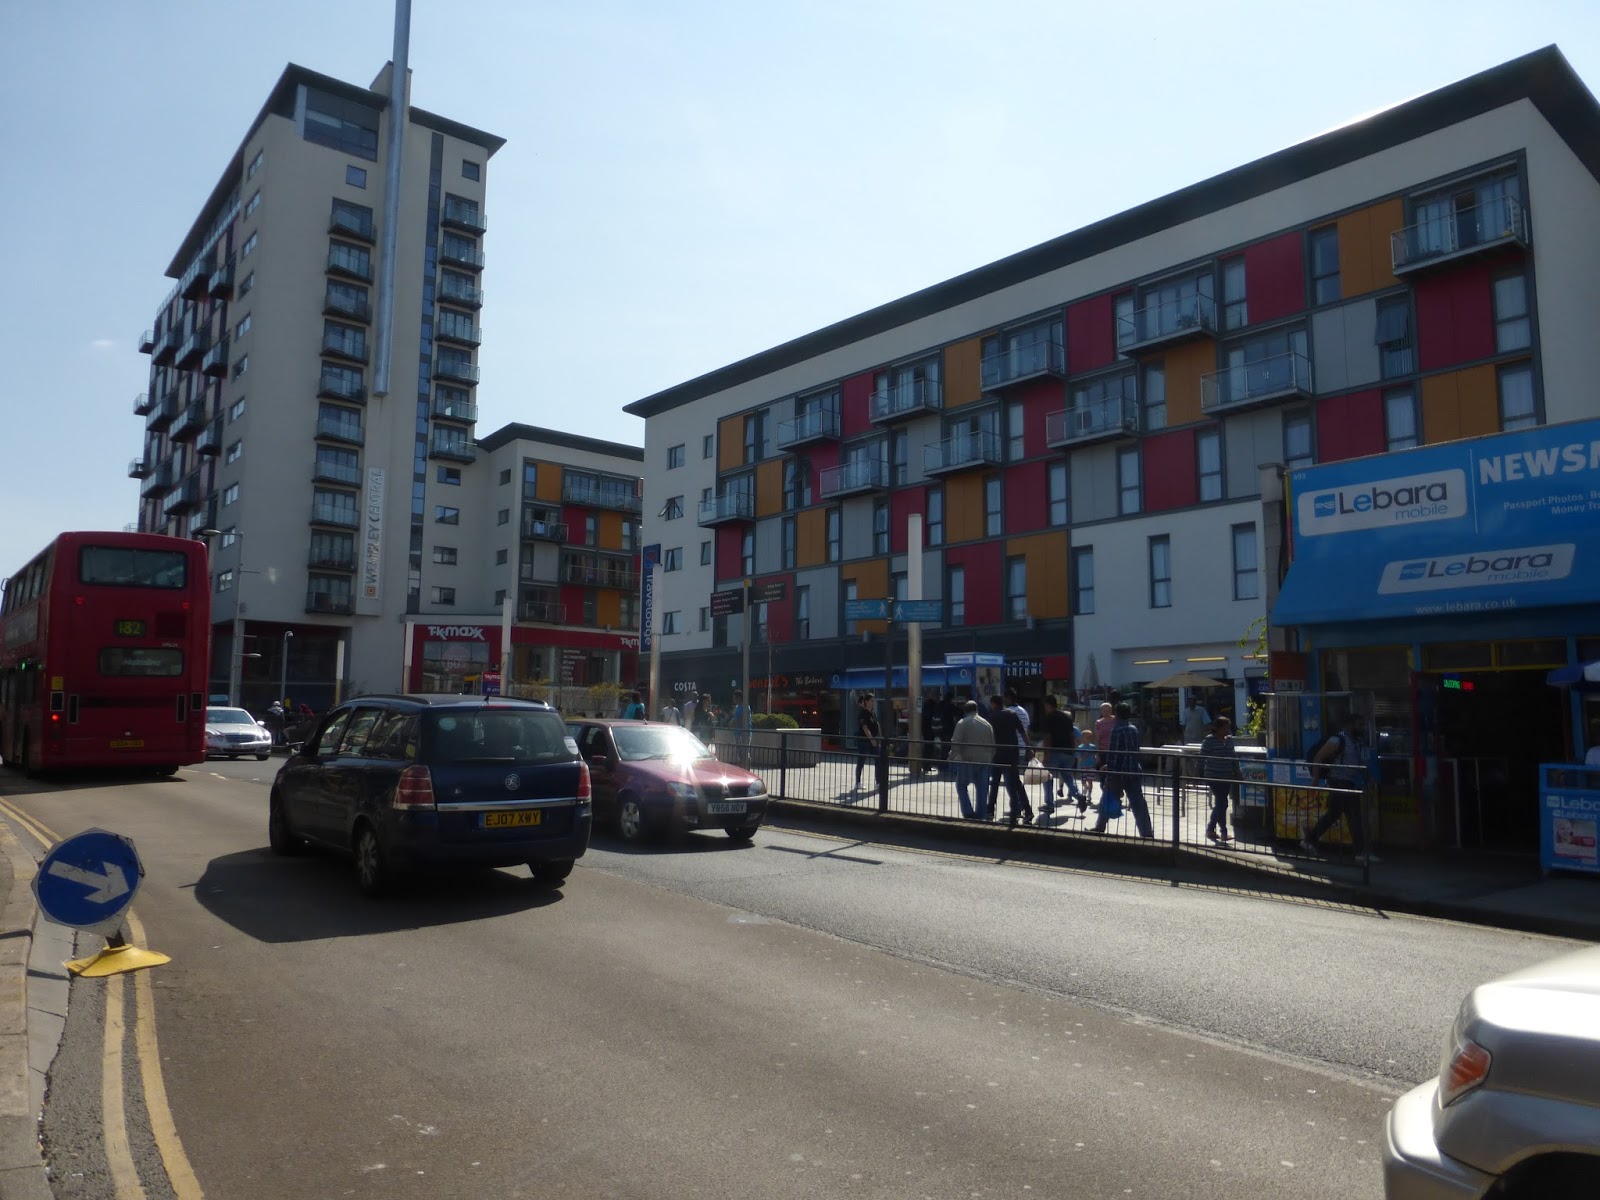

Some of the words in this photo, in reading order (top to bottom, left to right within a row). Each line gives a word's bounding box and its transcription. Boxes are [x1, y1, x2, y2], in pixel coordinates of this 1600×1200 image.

[369, 468, 383, 523] CENTRAL
[1339, 482, 1447, 514] Lebara
[1503, 499, 1546, 511] Passport
[1548, 493, 1584, 504] Photos
[1395, 503, 1448, 520] mobile
[1551, 504, 1585, 515] Money
[1428, 553, 1553, 578] Lebara
[1487, 569, 1549, 581] mobile
[118, 621, 142, 635] 182
[674, 681, 697, 692] COSTA
[485, 813, 515, 826] EJ07
[517, 812, 540, 825] XWY
